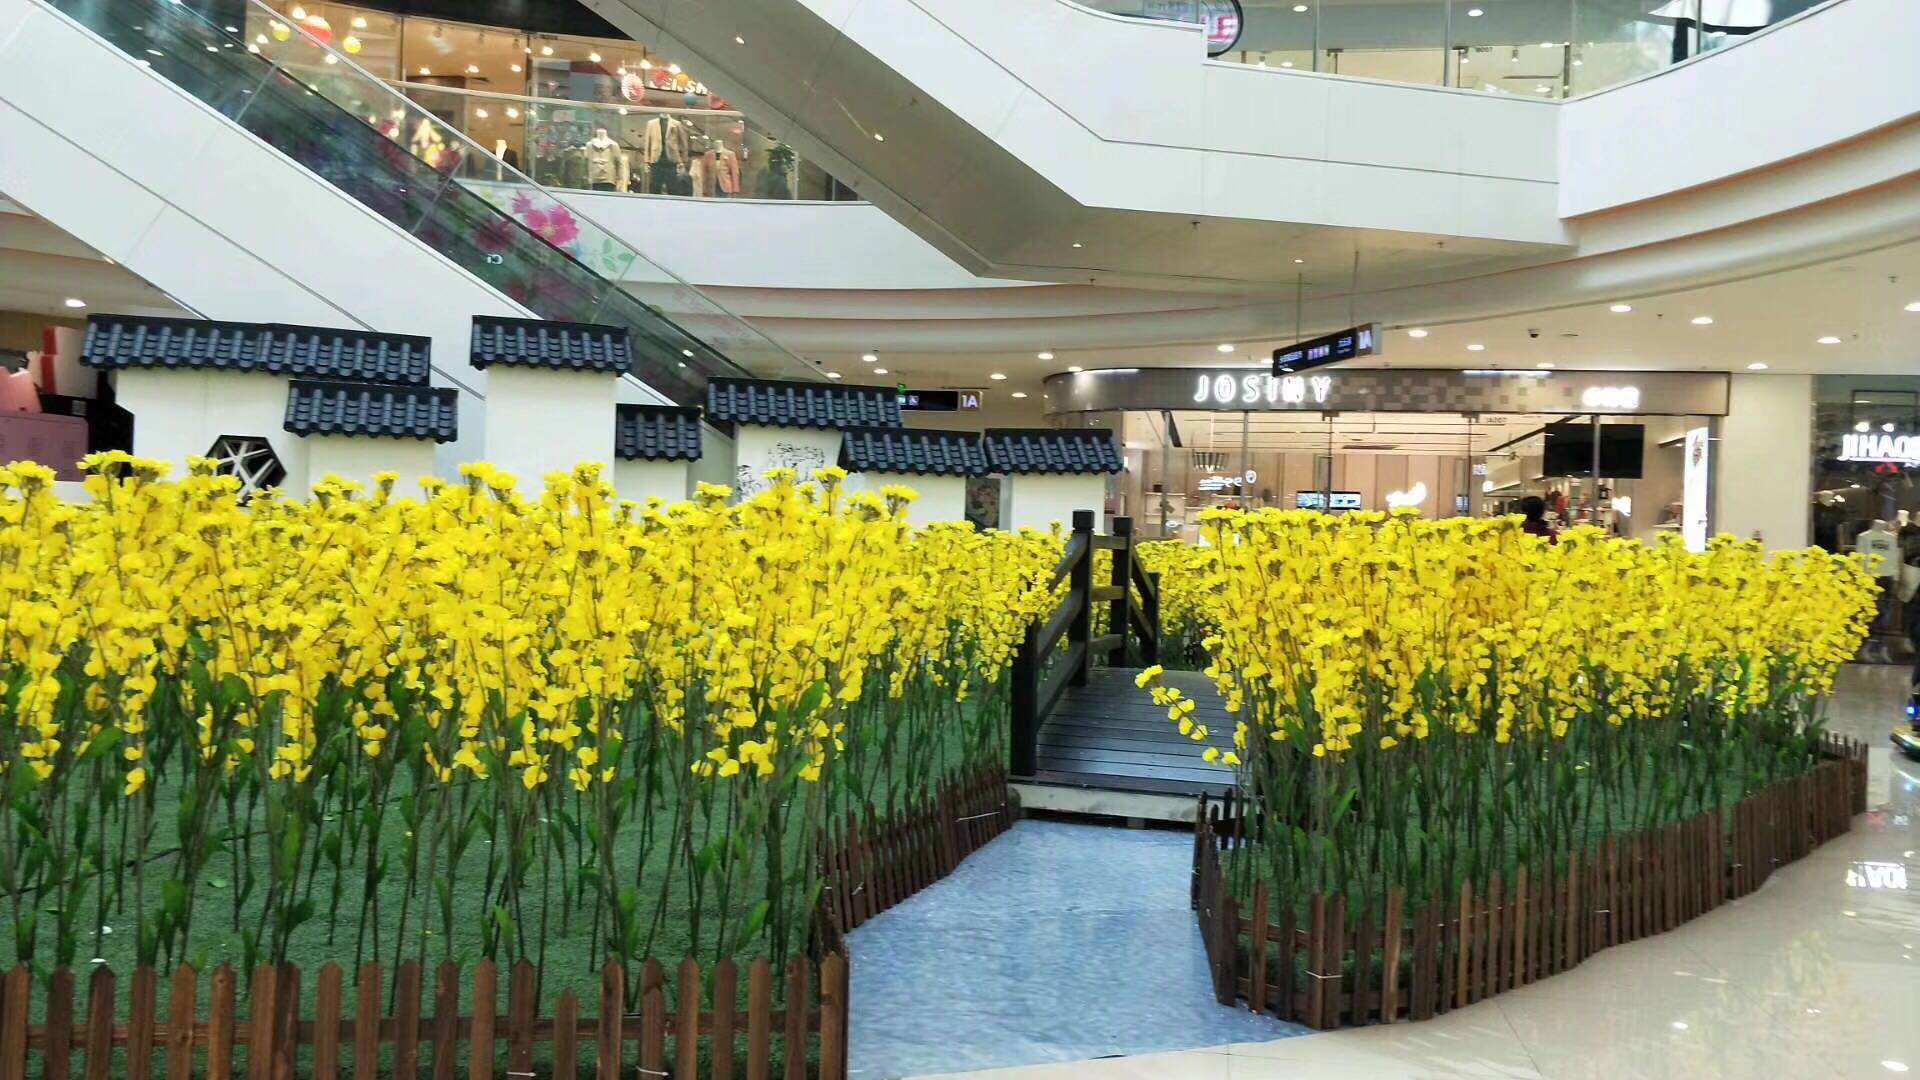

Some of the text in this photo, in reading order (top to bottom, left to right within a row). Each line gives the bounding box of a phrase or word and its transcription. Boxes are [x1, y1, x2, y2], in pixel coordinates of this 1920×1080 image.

[961, 394, 978, 408] 1A
[1193, 374, 1331, 403] JOSINY
[1837, 434, 1920, 461] JIHAO
